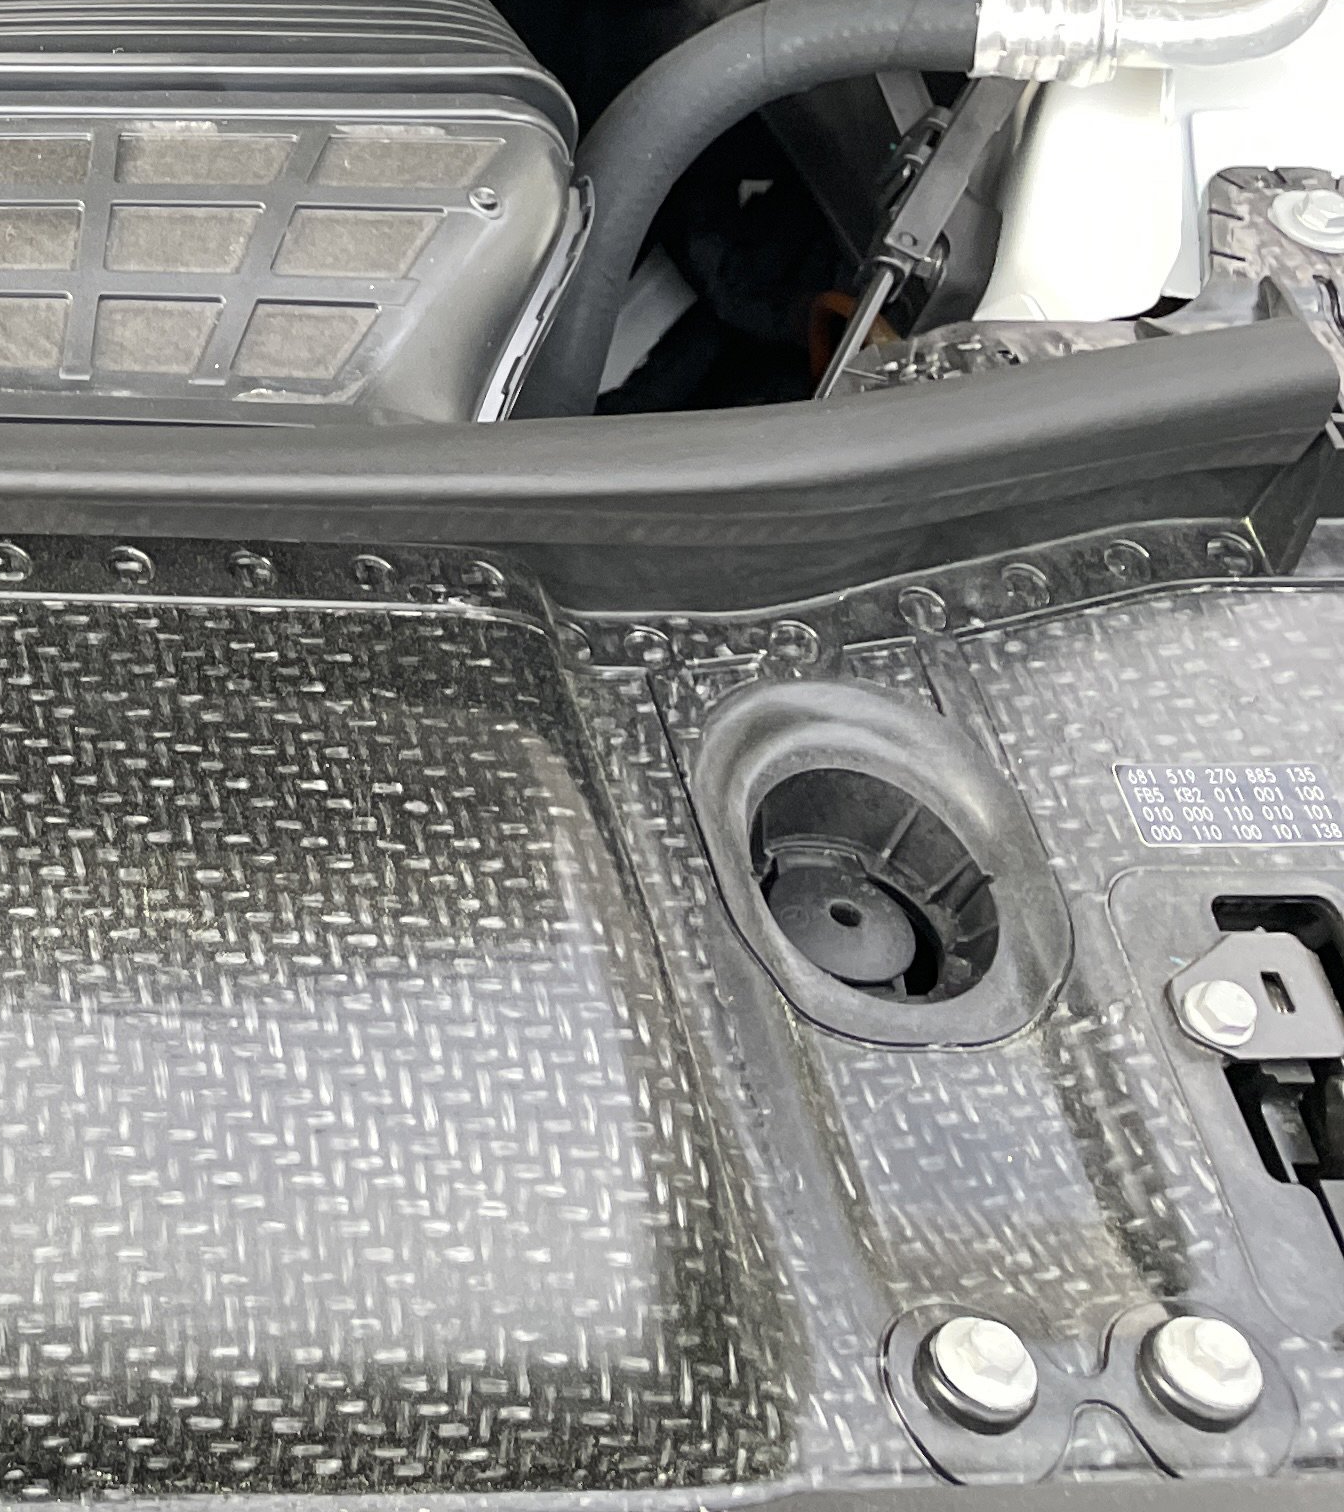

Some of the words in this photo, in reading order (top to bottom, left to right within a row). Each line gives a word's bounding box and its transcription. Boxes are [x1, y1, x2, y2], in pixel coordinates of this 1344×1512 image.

[1128, 769, 1156, 784] 681
[1166, 769, 1196, 784] 519
[1205, 769, 1237, 784] 270
[1287, 767, 1316, 782] 135
[1214, 787, 1244, 803] 011
[1253, 787, 1284, 801] 001
[1295, 786, 1325, 801] 100
[1143, 807, 1173, 822] 010
[1183, 807, 1213, 822] 000
[1224, 806, 1253, 821] 110
[1262, 805, 1293, 820] 010
[1304, 805, 1333, 820] 101
[1151, 826, 1182, 841] 000
[1193, 825, 1223, 840] 110
[1233, 825, 1262, 840] 100
[1272, 824, 1301, 839] 101
